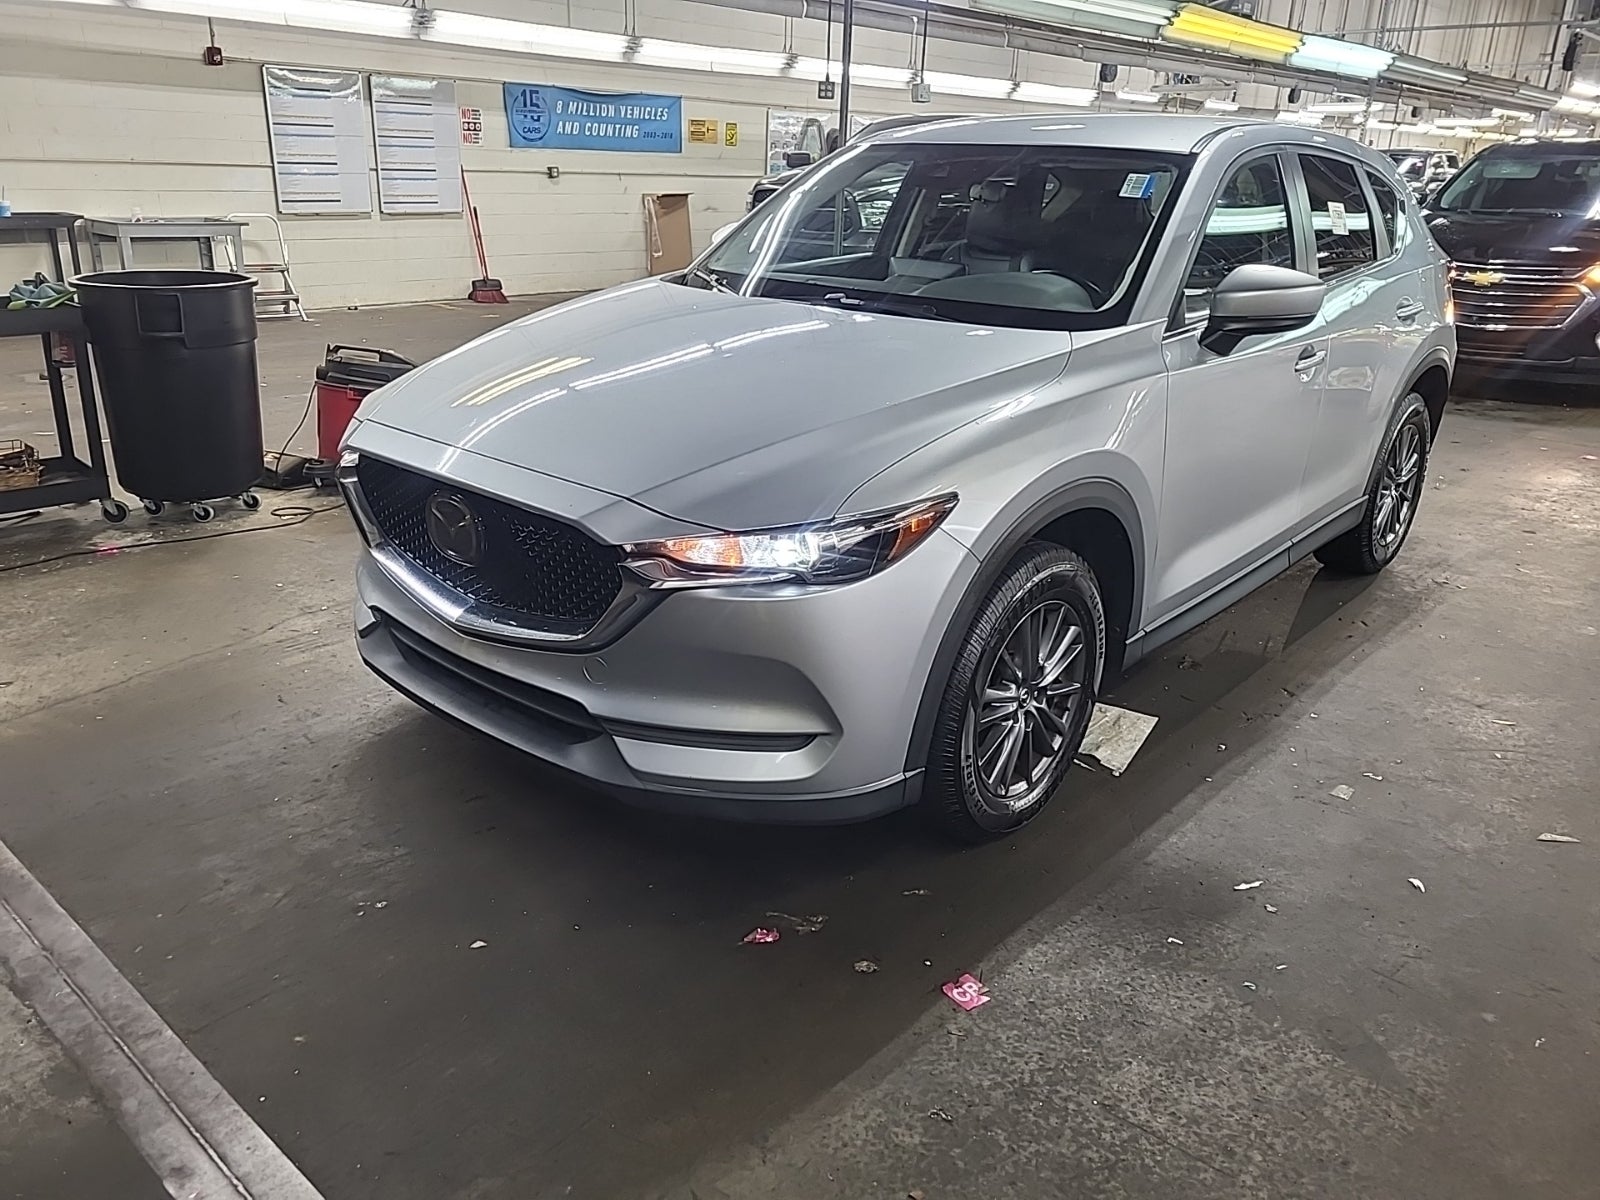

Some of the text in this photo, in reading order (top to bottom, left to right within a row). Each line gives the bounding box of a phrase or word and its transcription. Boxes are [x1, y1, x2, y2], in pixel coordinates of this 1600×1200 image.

[461, 108, 471, 120] NO
[556, 100, 669, 121] 8 MILLION VEHICLES
[522, 126, 541, 134] CARS
[556, 121, 580, 135] AND
[584, 122, 640, 138] COUNTING
[462, 132, 473, 144] NO
